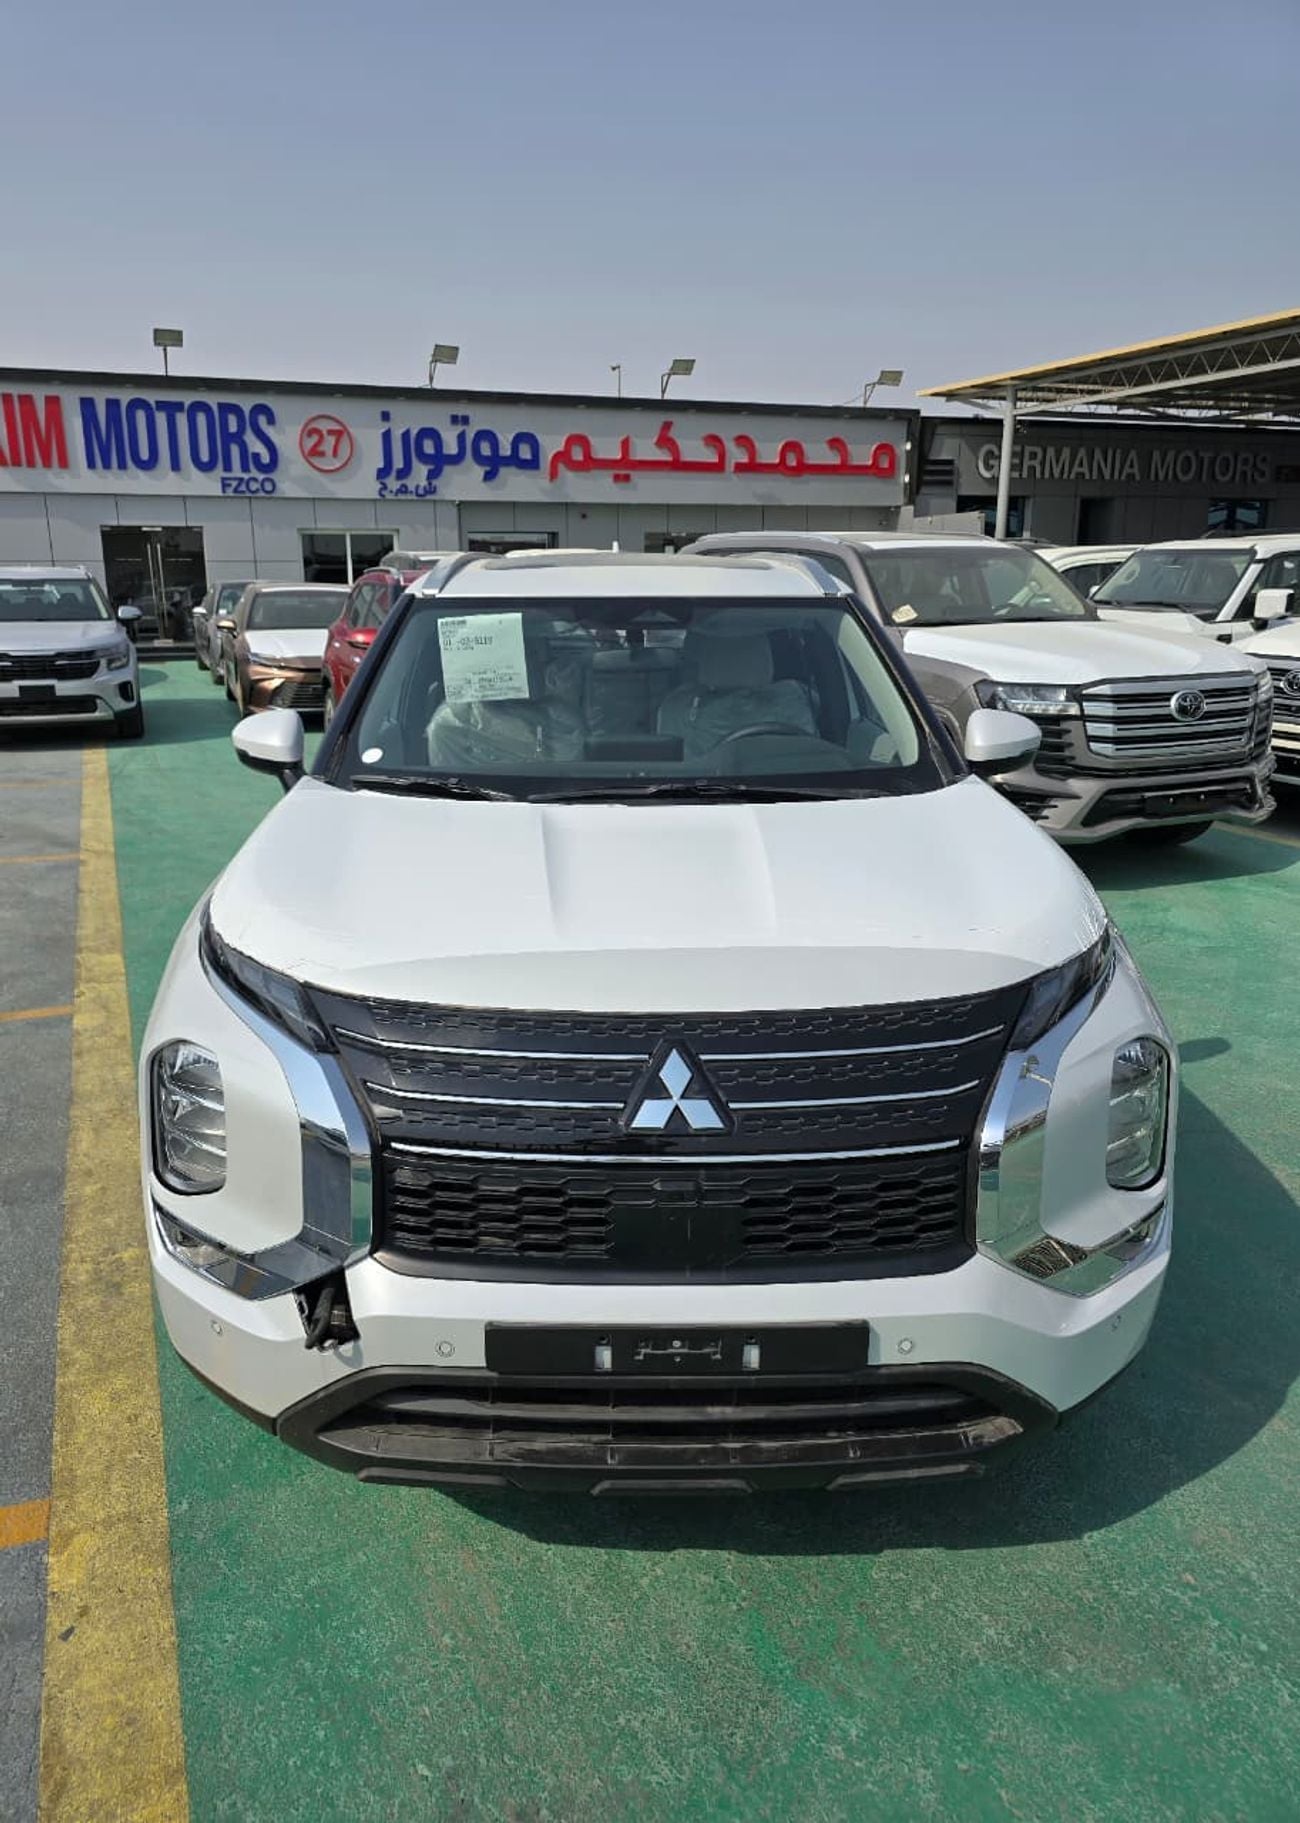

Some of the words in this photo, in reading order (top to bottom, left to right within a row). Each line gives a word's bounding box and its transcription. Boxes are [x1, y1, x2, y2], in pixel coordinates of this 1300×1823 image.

[0, 393, 69, 469] IM
[79, 397, 279, 474] MOTORS
[306, 427, 346, 459] 27
[376, 411, 541, 482] موتورز
[978, 444, 1141, 481] GERMANIA
[1151, 450, 1273, 483] MOTORS
[221, 477, 277, 494] FZCO
